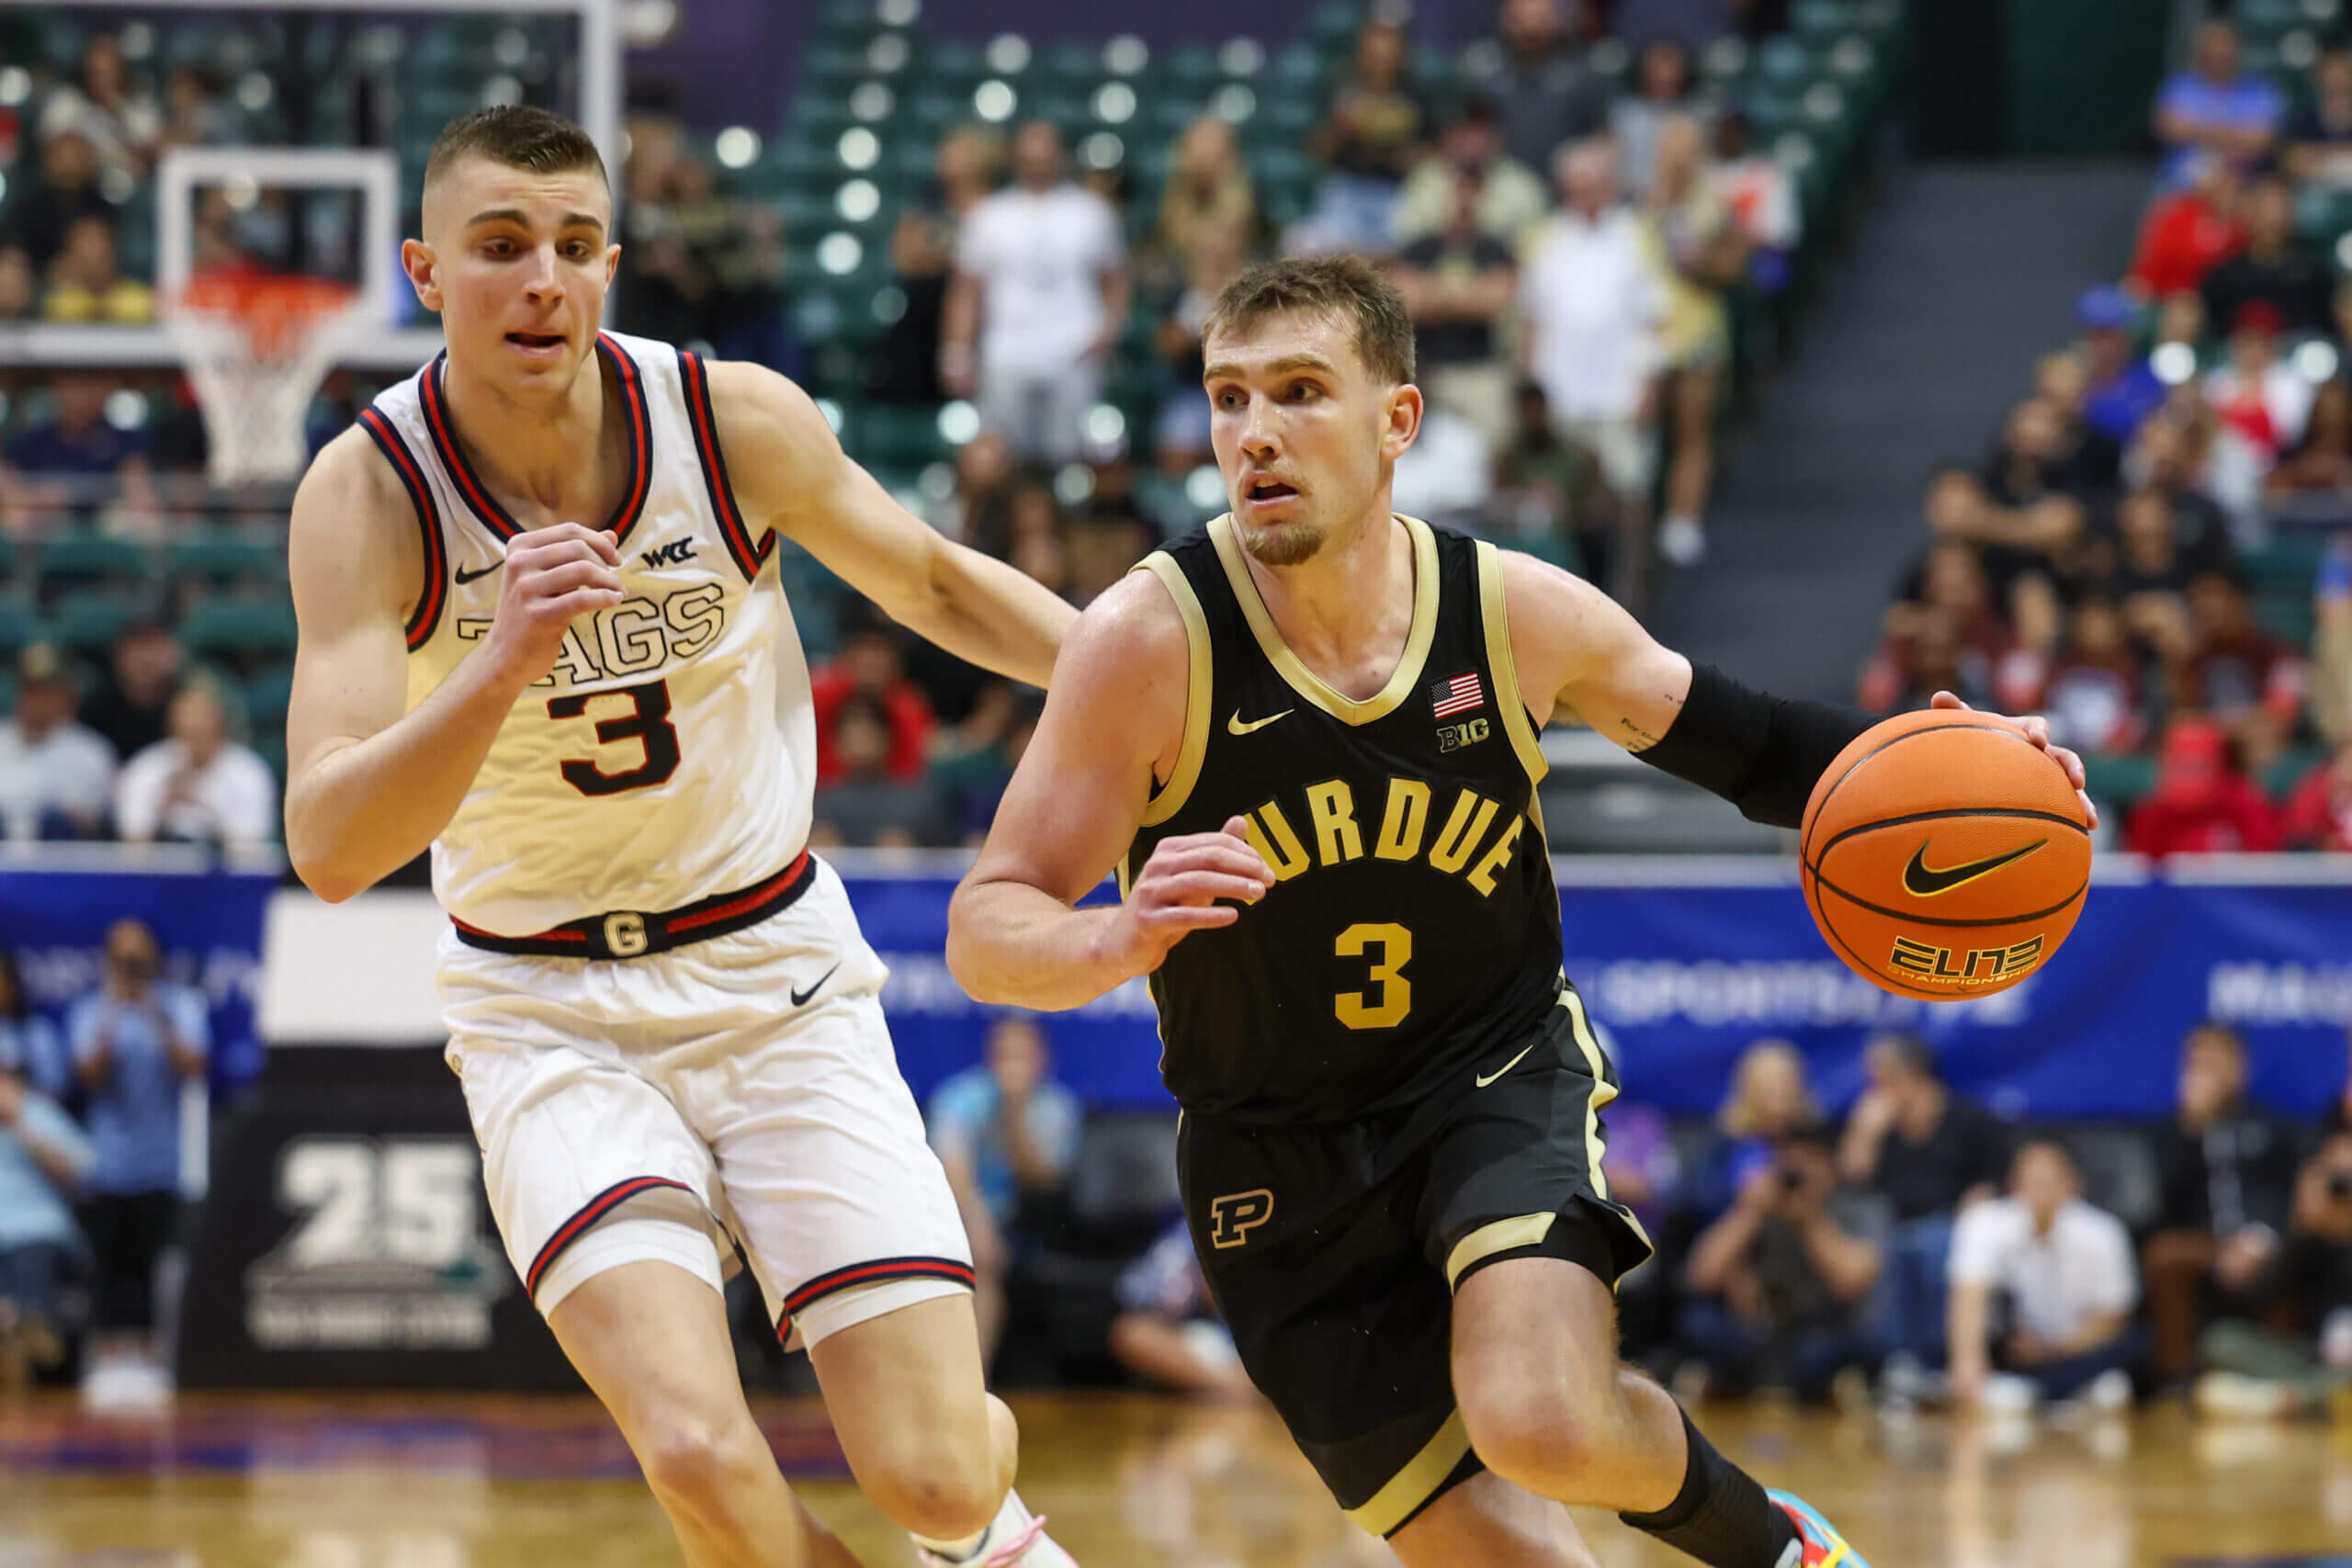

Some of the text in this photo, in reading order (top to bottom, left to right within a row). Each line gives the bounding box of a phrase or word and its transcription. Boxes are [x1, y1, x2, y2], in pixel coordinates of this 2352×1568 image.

[640, 536, 698, 570] WCC
[458, 582, 725, 688] AGS
[547, 677, 682, 797] 3
[1436, 717, 1490, 753] BIG
[1240, 776, 1524, 908] URDUE
[603, 911, 649, 957] G
[1334, 921, 1413, 1030] 3
[1889, 932, 2046, 979] ELITE
[281, 1139, 476, 1269] 25
[1210, 1188, 1274, 1250] P
